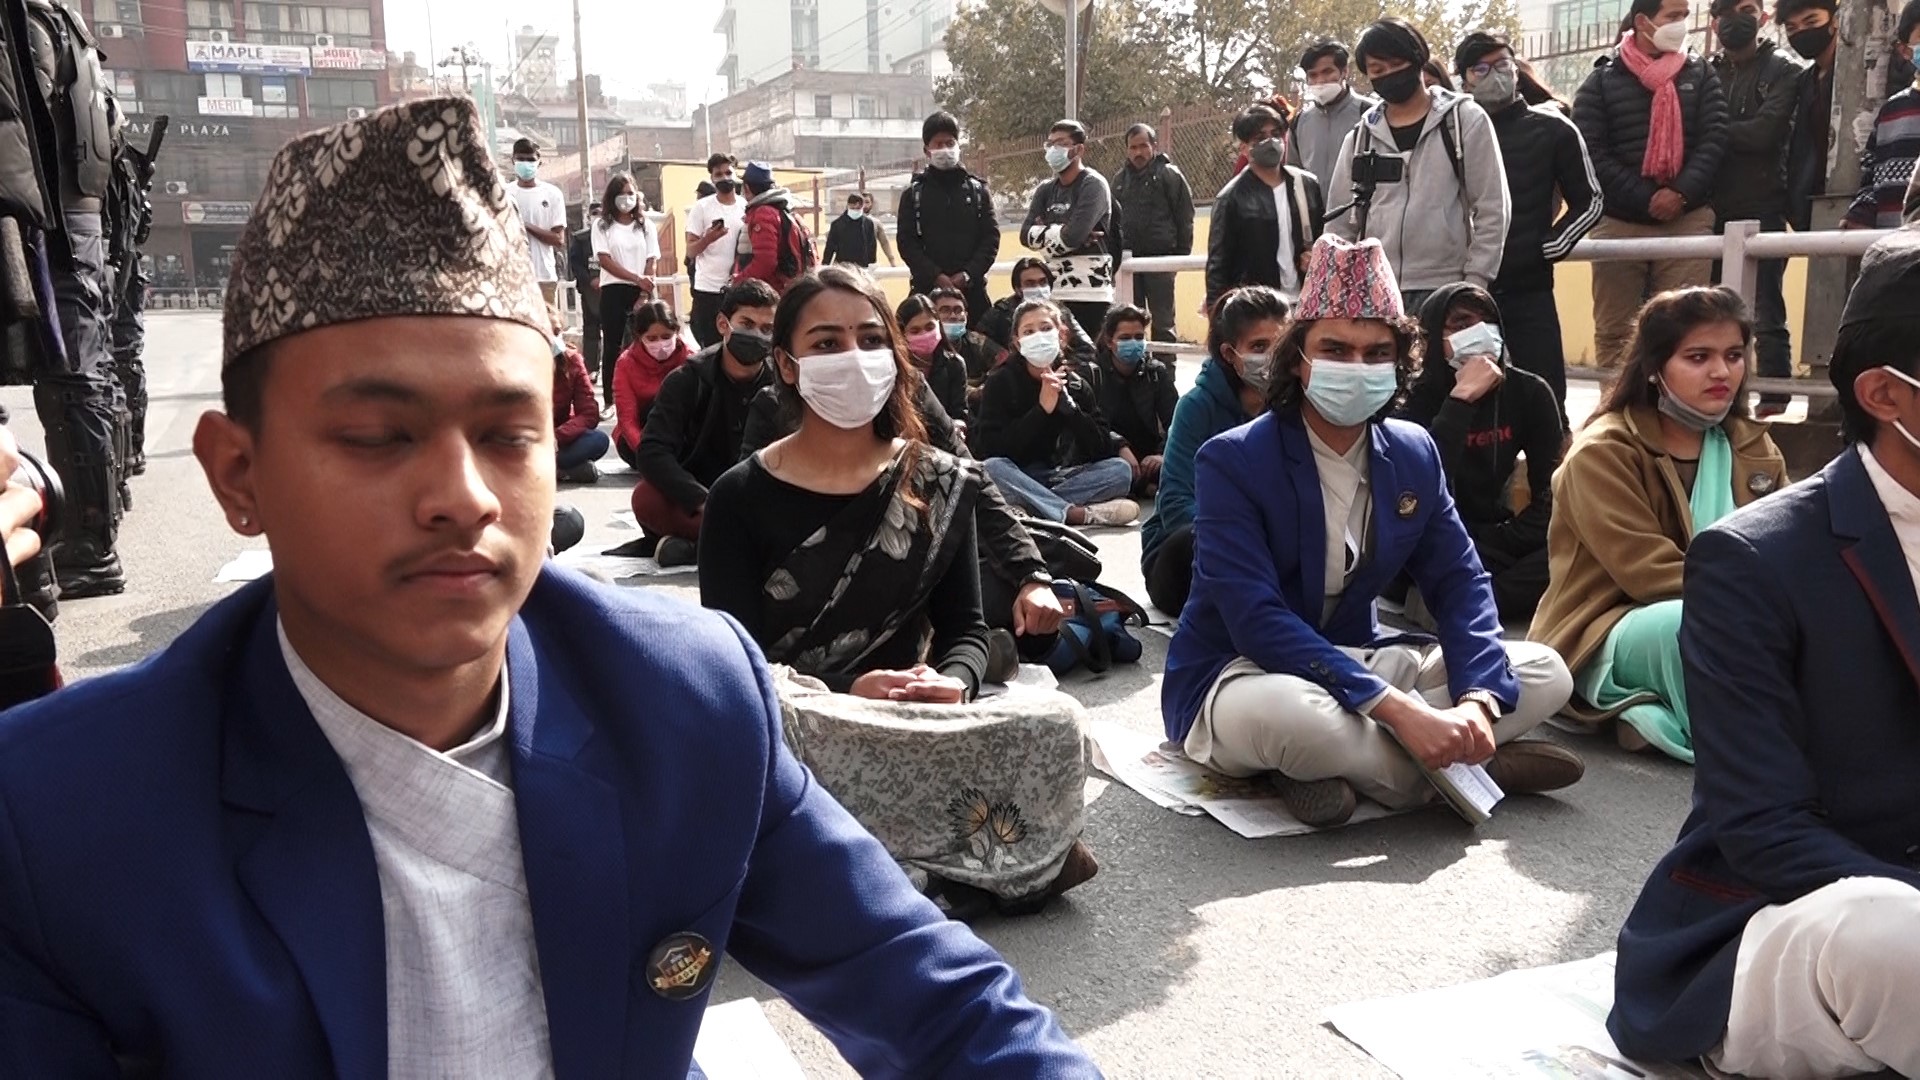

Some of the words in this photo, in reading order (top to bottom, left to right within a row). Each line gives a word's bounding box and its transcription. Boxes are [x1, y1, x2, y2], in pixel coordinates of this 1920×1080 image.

[211, 45, 264, 60] MAPLE
[206, 99, 242, 113] MERIT
[181, 124, 230, 136] PLAZA
